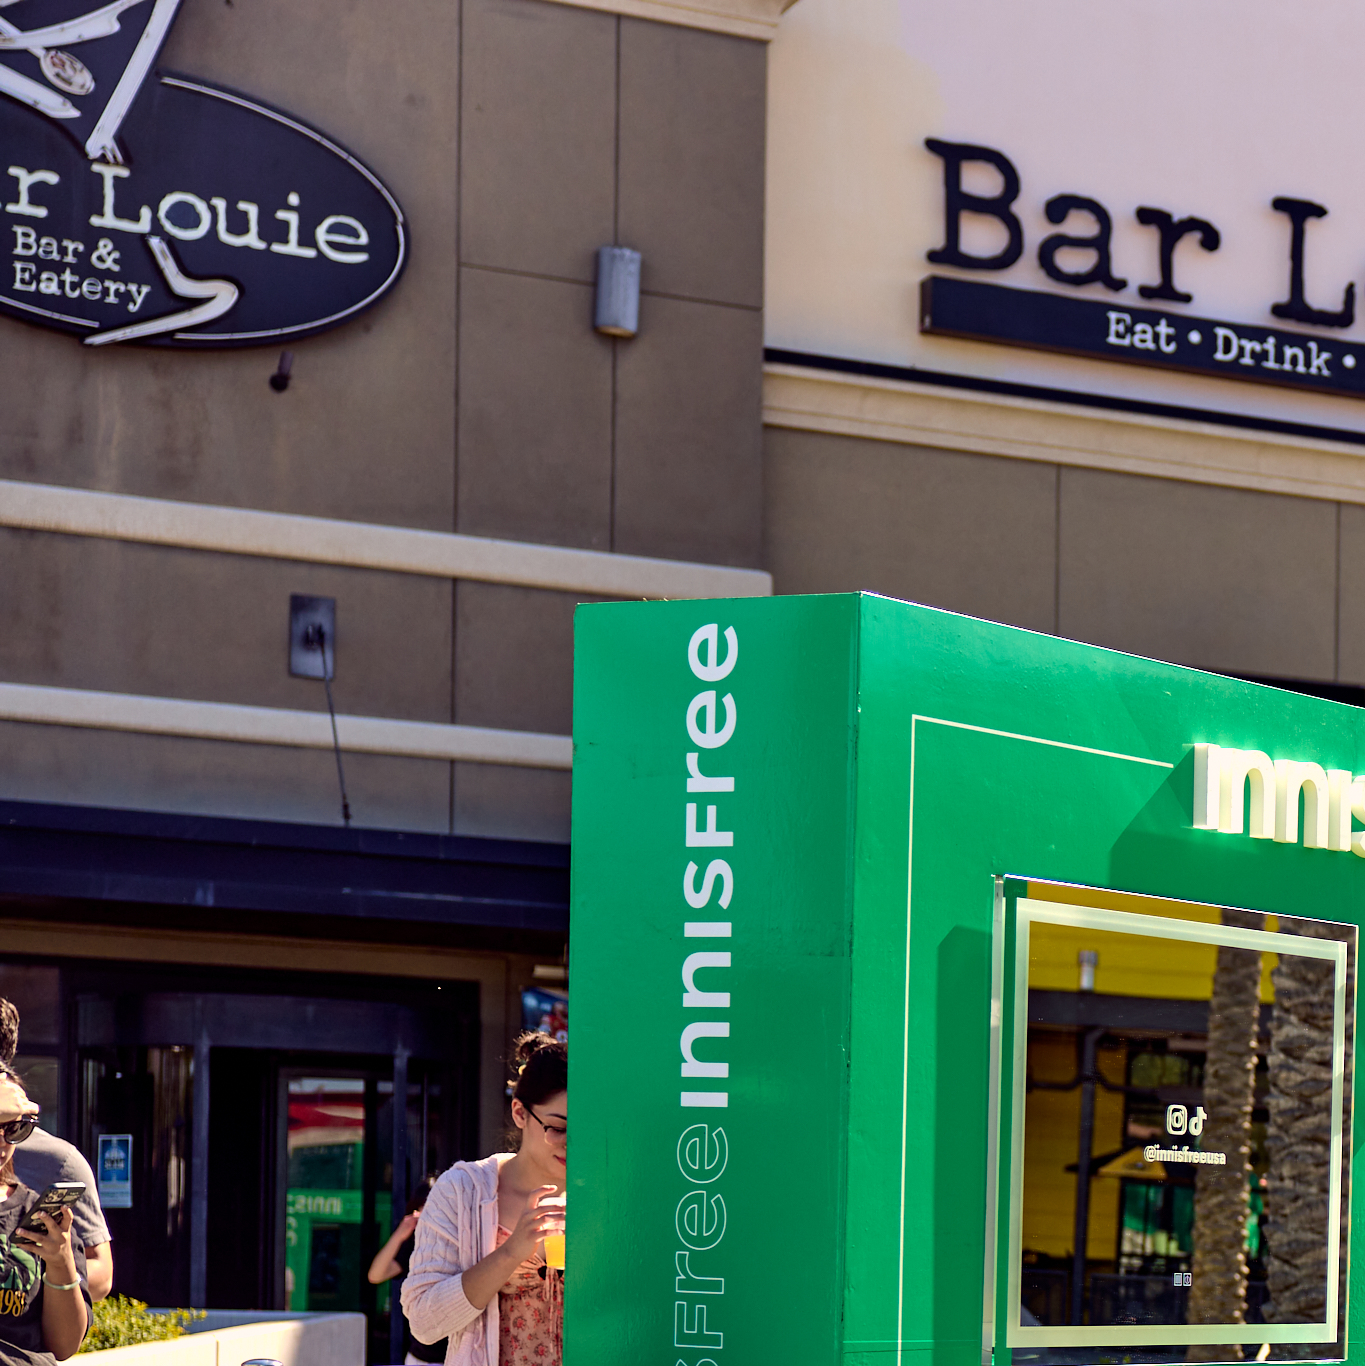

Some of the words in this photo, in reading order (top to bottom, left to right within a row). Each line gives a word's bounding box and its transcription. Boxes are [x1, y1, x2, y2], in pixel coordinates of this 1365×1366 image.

[89, 162, 371, 265] Louie
[924, 137, 1221, 304] Bar
[12, 225, 85, 264] Bar
[90, 237, 121, 272] &
[12, 261, 152, 313] Eatery
[1106, 310, 1179, 354] Eat
[1213, 325, 1334, 378] Drink
